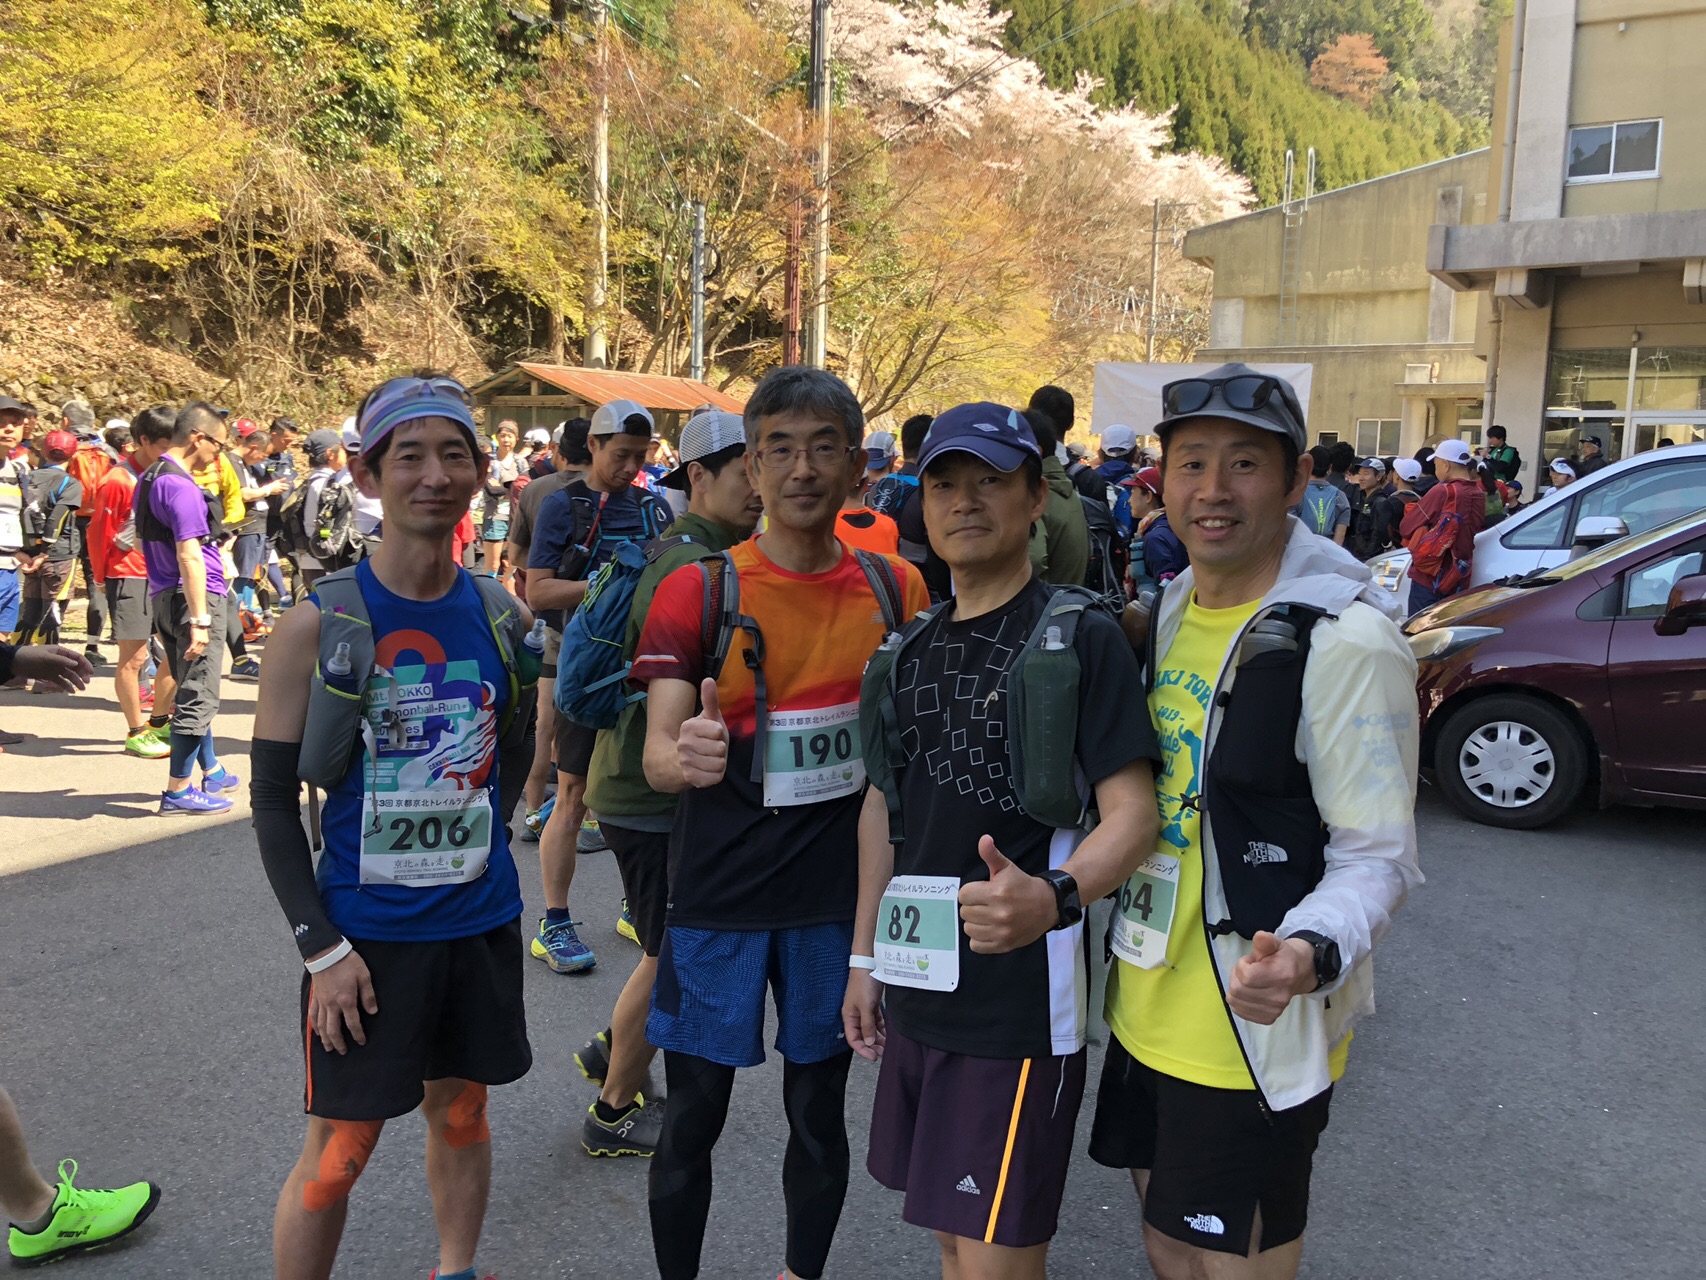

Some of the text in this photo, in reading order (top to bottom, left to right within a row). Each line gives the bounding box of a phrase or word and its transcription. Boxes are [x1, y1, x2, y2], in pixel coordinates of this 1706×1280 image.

[396, 685, 431, 698] OKKO
[369, 702, 461, 719] Cnonball-Run
[789, 727, 852, 768] 190
[388, 815, 471, 851] 206
[1247, 841, 1266, 850] THE
[888, 904, 921, 944] 82
[956, 1184, 981, 1195] adidas
